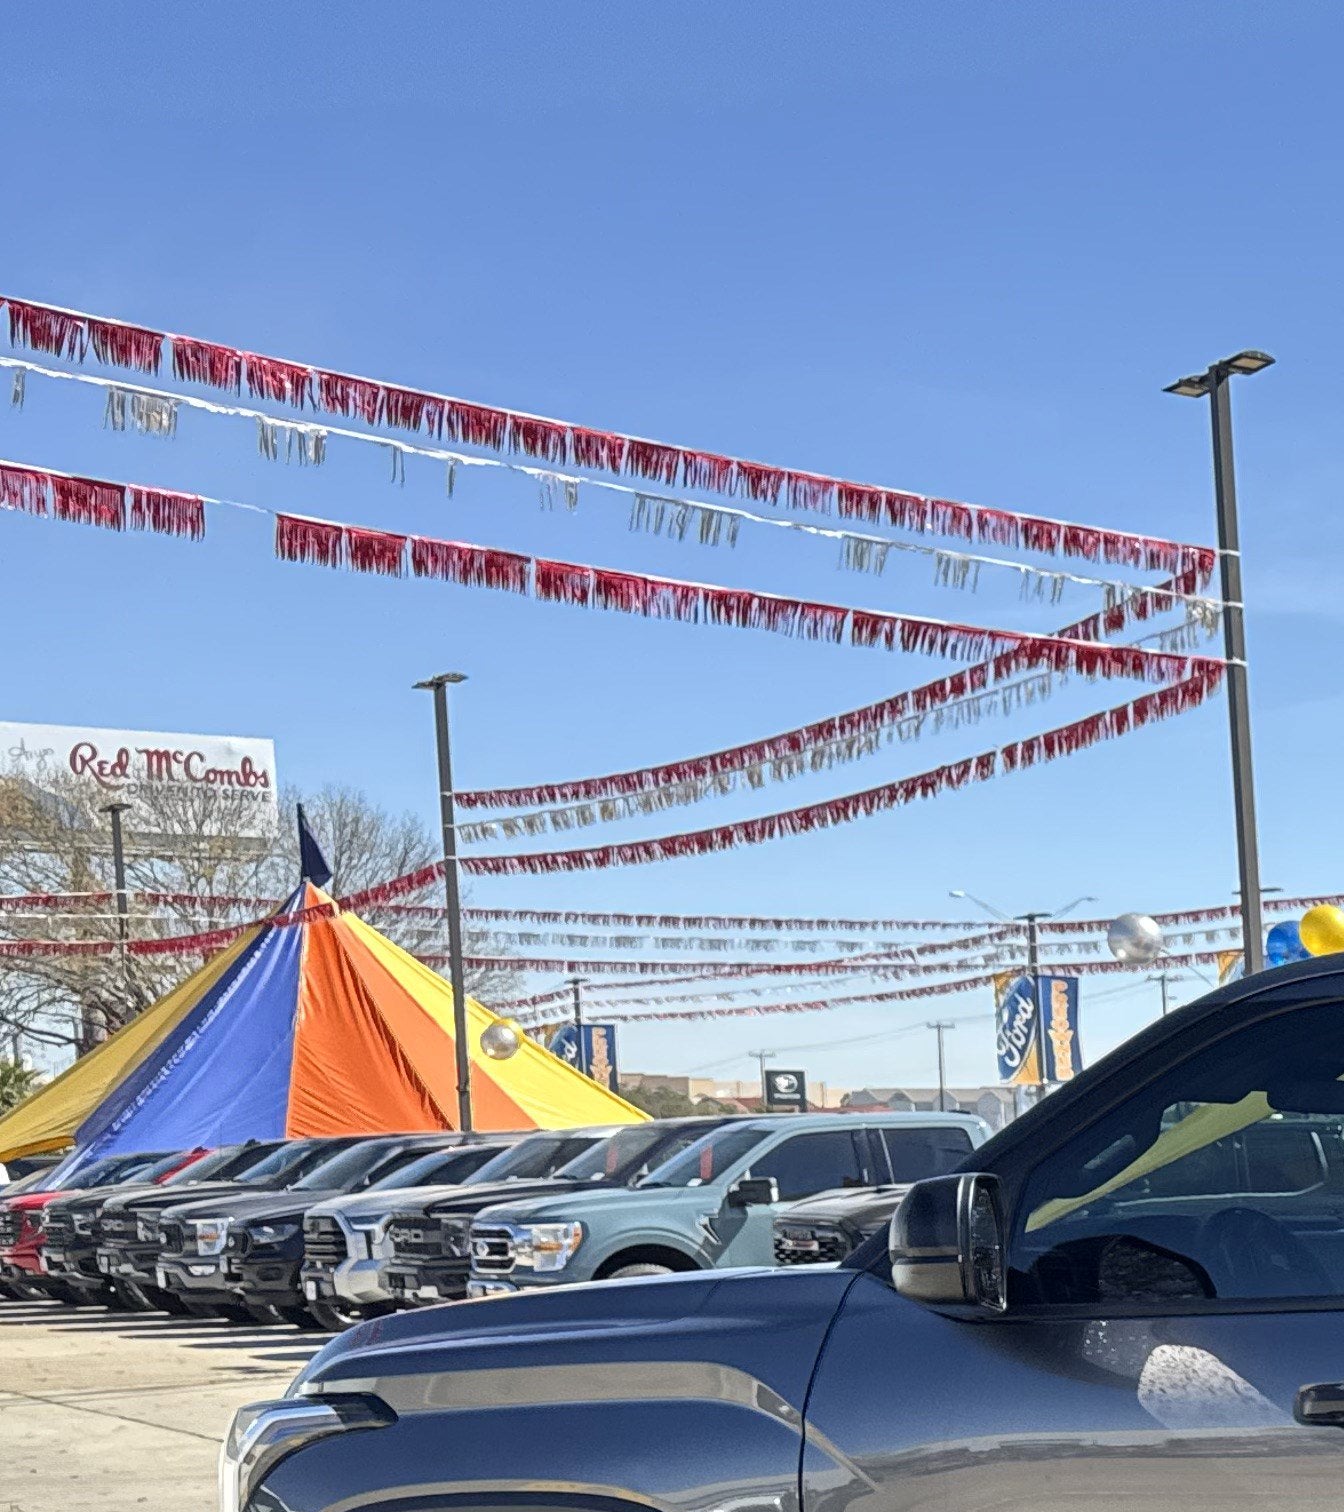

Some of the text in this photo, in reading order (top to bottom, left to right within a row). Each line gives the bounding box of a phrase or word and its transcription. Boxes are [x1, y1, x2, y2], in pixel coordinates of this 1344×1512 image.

[69, 742, 130, 790] Red
[135, 747, 270, 789] McCombs
[222, 788, 272, 803] SERVE
[997, 993, 1035, 1068] Ford
